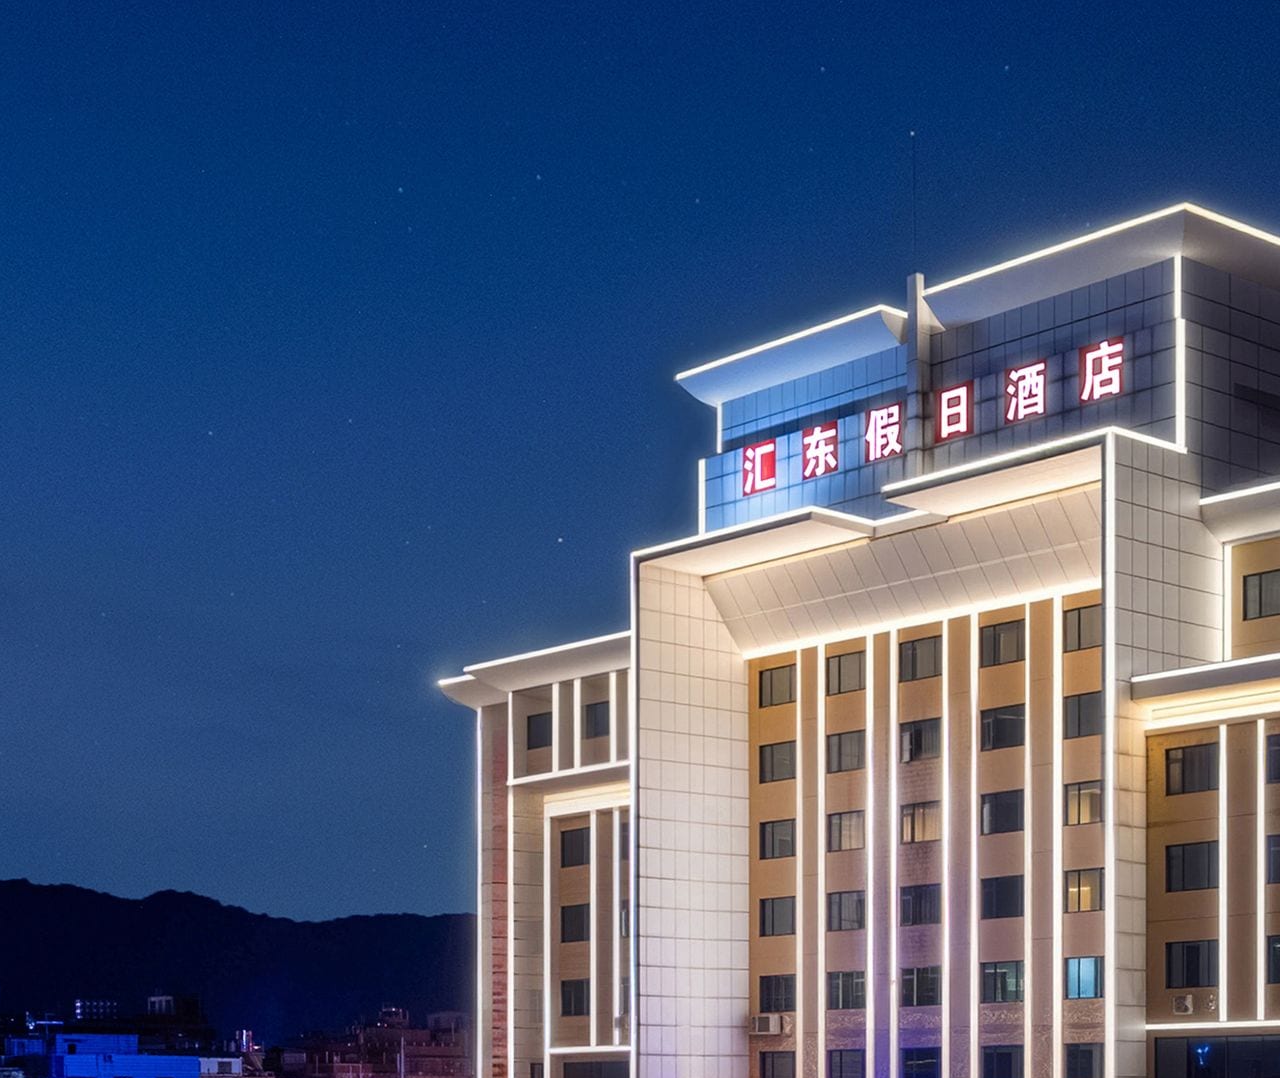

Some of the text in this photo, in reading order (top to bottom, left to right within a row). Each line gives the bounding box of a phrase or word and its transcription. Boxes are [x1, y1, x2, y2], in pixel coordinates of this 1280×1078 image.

[743, 340, 1124, 494] 汇东假日酒店
